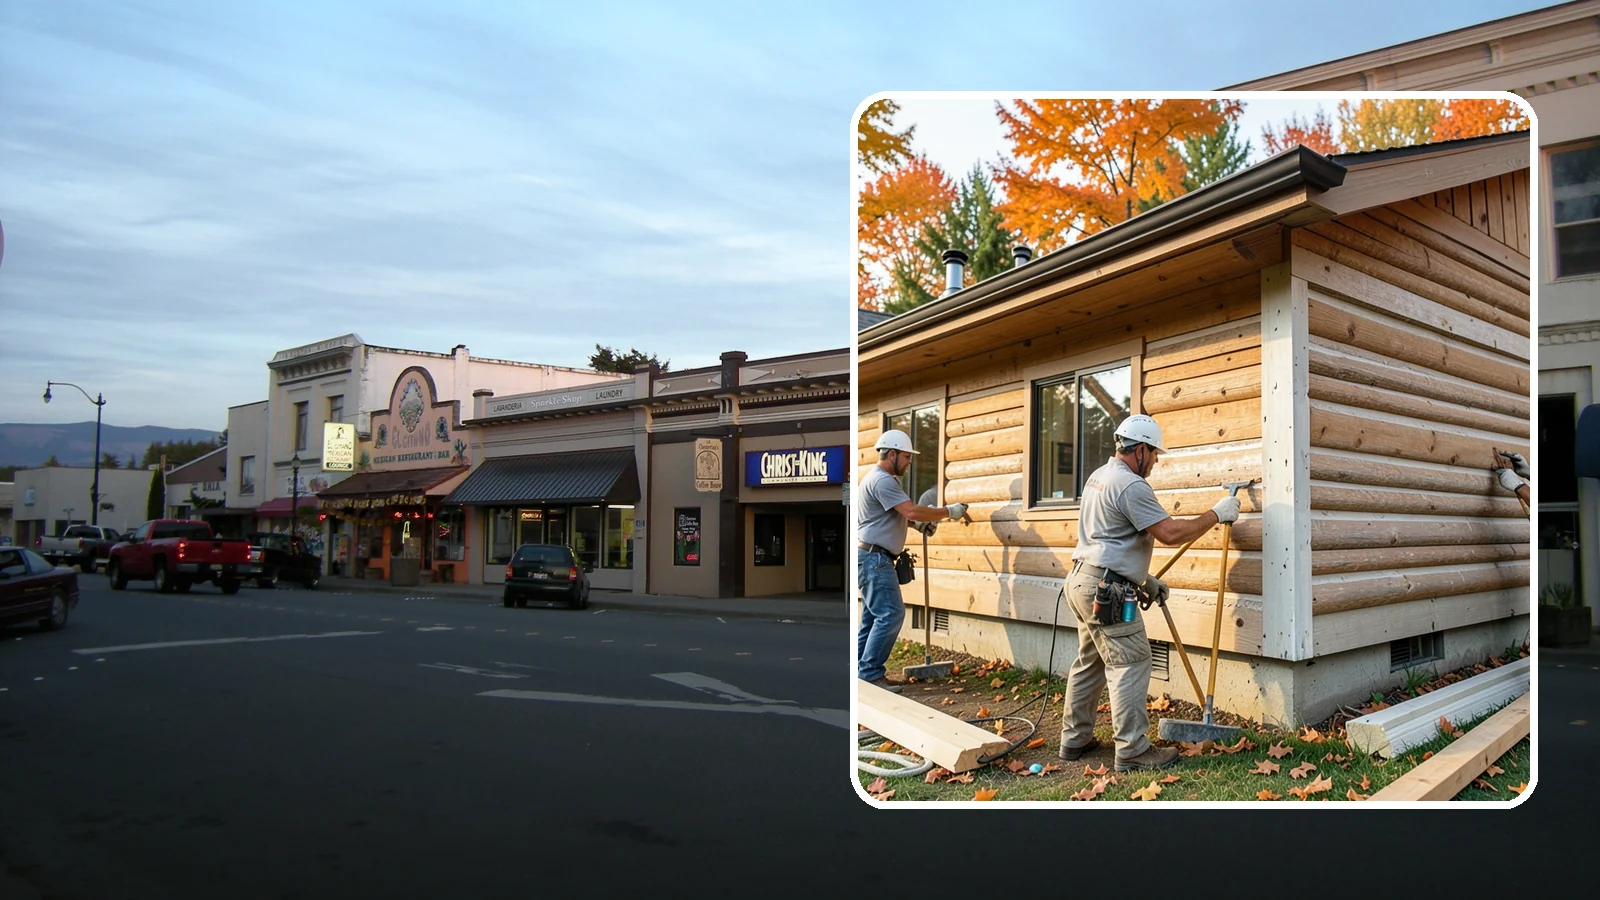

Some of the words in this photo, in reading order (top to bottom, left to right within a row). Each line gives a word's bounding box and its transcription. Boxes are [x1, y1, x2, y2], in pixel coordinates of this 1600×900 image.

[561, 394, 583, 405] Shop
[595, 389, 623, 400] LAUNDRY
[493, 402, 522, 412] LAVANDERIA
[373, 455, 396, 464] MEXICAN
[397, 452, 433, 463] RESTAURANT
[438, 450, 450, 459] BAR
[799, 449, 827, 476] KING
